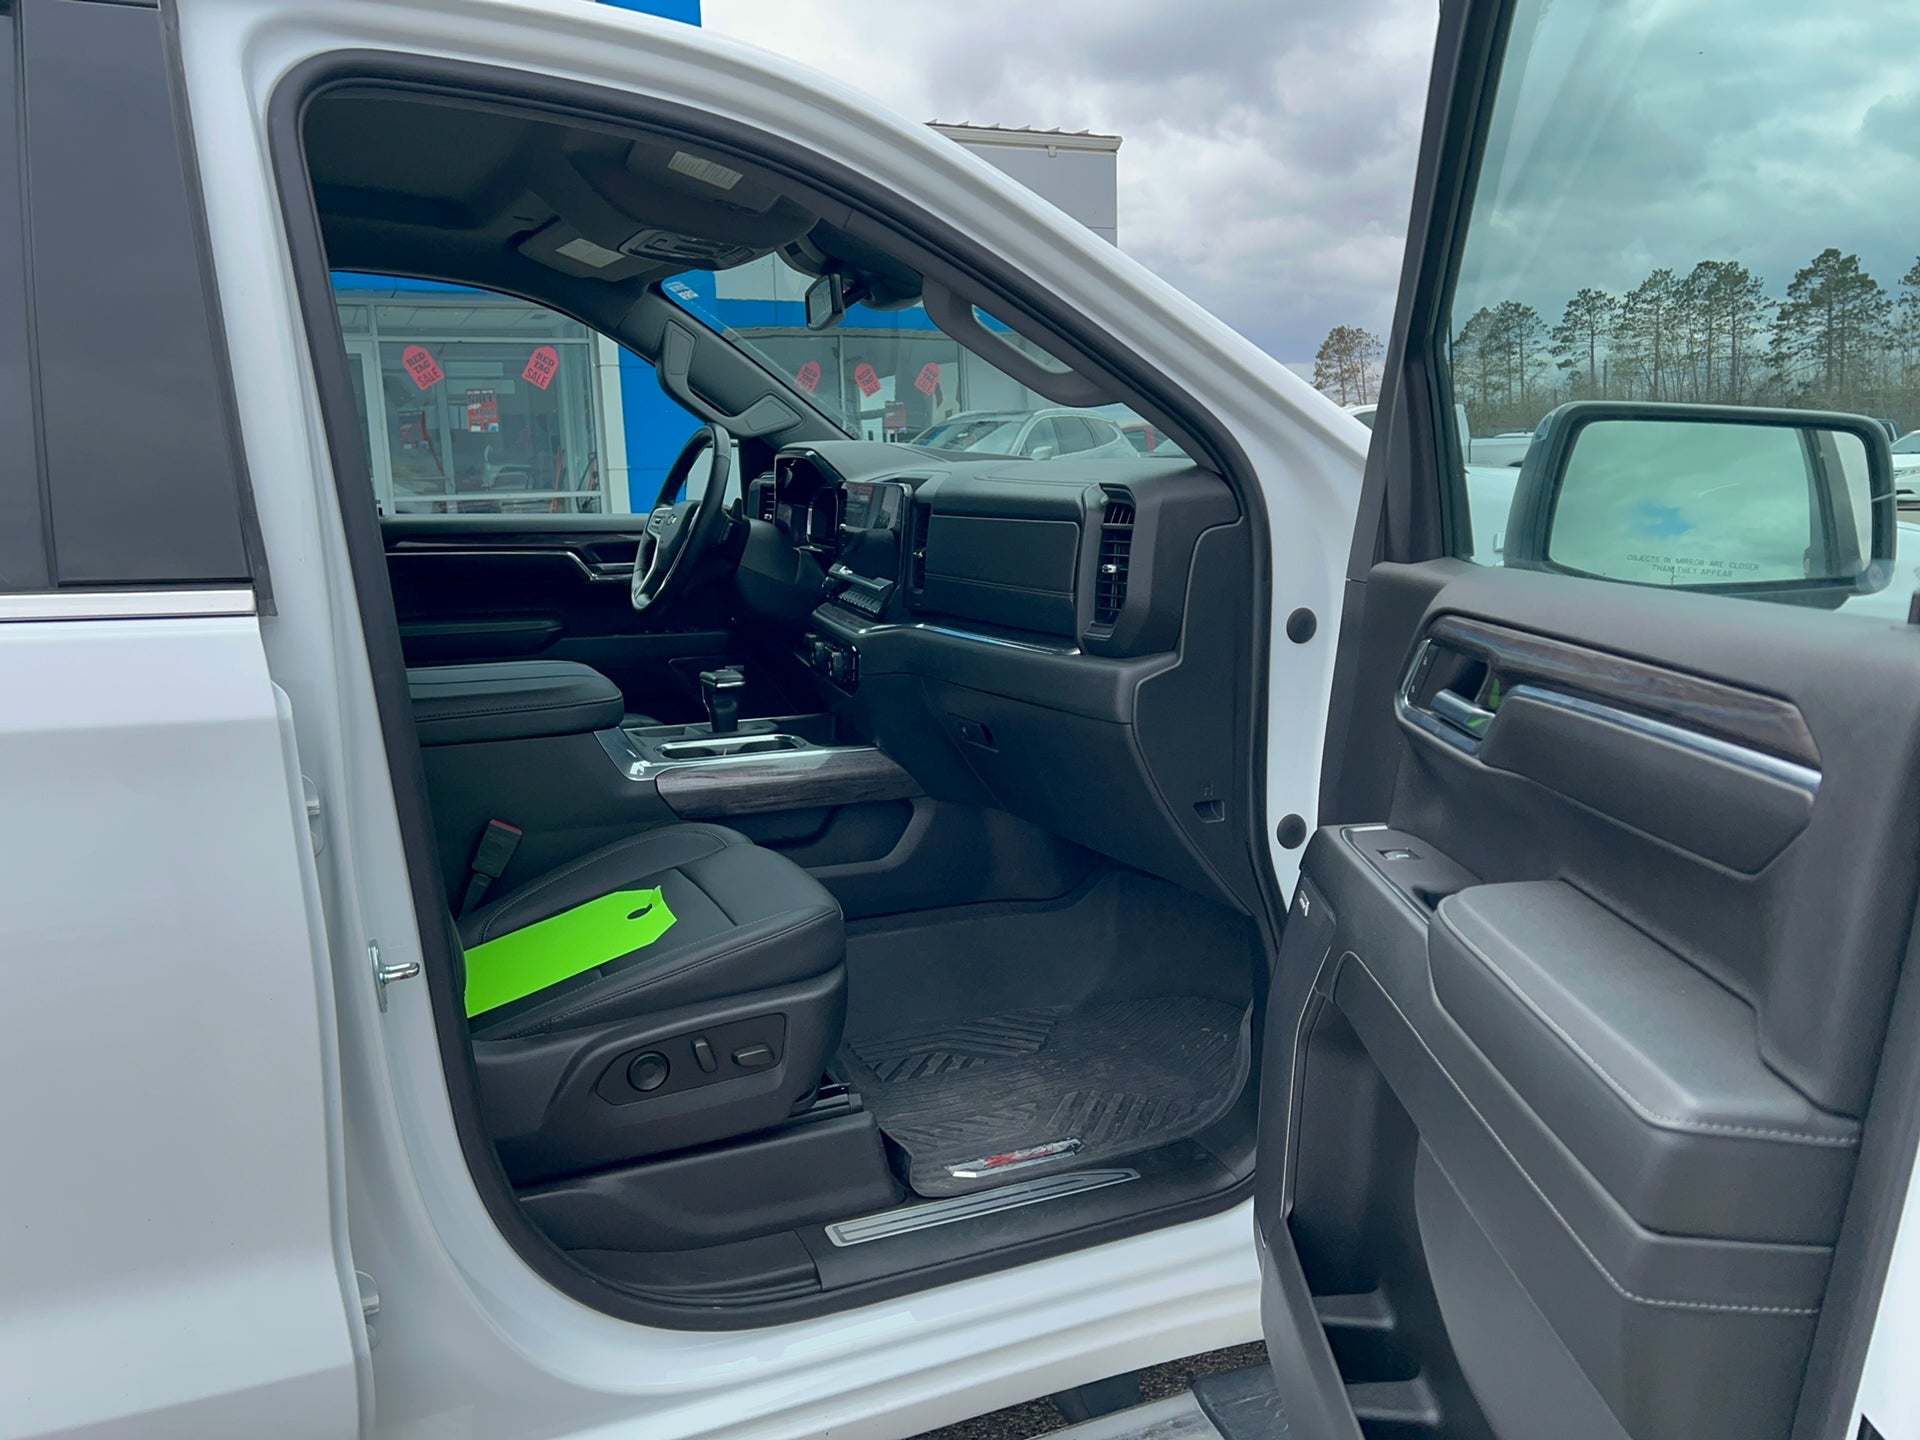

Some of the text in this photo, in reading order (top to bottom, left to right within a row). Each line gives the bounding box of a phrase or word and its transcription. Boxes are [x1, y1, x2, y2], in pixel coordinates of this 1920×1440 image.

[406, 352, 426, 367] RED
[536, 351, 555, 367] RED
[413, 361, 431, 374] TAG
[533, 361, 550, 374] TAG
[417, 368, 441, 388] SALE
[524, 368, 549, 388] SALE
[1627, 554, 1660, 564] OBJECTS
[1676, 557, 1705, 566] MIRROR
[1709, 560, 1725, 568] ARE
[1729, 562, 1760, 571] CLOSER
[1652, 564, 1733, 578] THAN THEY APPEAR
